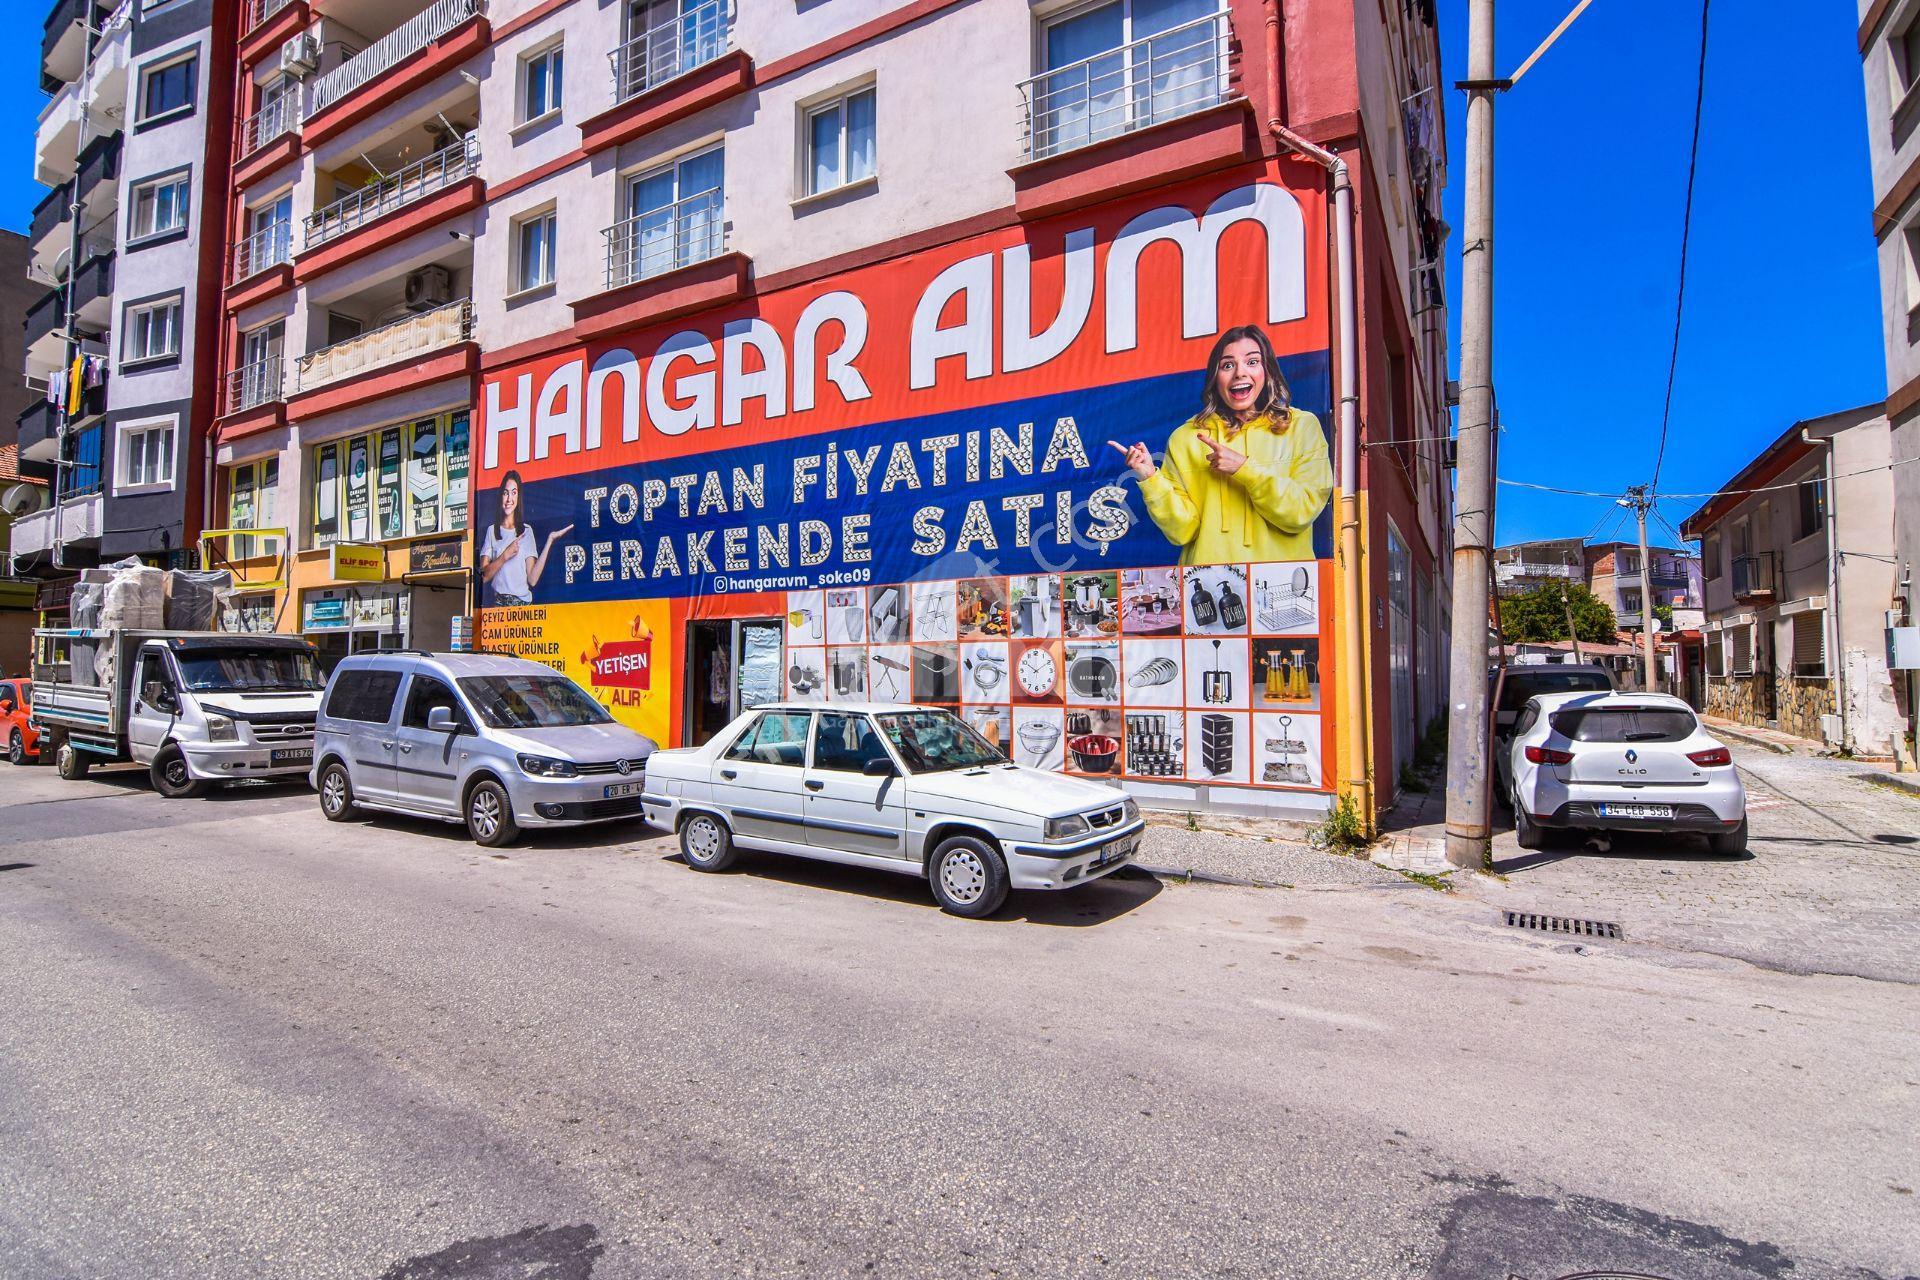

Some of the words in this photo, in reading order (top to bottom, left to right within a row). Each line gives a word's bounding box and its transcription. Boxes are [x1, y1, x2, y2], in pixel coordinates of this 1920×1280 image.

[484, 290, 872, 470] HANGAR
[910, 182, 1307, 391] AVM
[584, 463, 765, 528] TOPTAN
[793, 416, 1091, 505] FİYATINA
[564, 513, 872, 585] PERAKENDE
[910, 486, 1130, 557] SATIŞ
[340, 556, 357, 566] ELİF
[358, 559, 379, 568] SPOT
[730, 567, 871, 593] hangaravm_soke09
[482, 611, 505, 627] ÇEYİZ
[506, 606, 547, 622] ÜRÜNLERİ
[482, 628, 502, 640] CAM
[503, 625, 543, 639] ÜRÜNLER
[482, 641, 516, 655] PLASTİK
[518, 640, 560, 656] ÜRÜNLER
[596, 651, 648, 676] YETİŞEN
[611, 689, 641, 707] ALIR
[610, 786, 618, 796] 20
[1606, 804, 1620, 815] 34
[1649, 805, 1670, 817] 558
